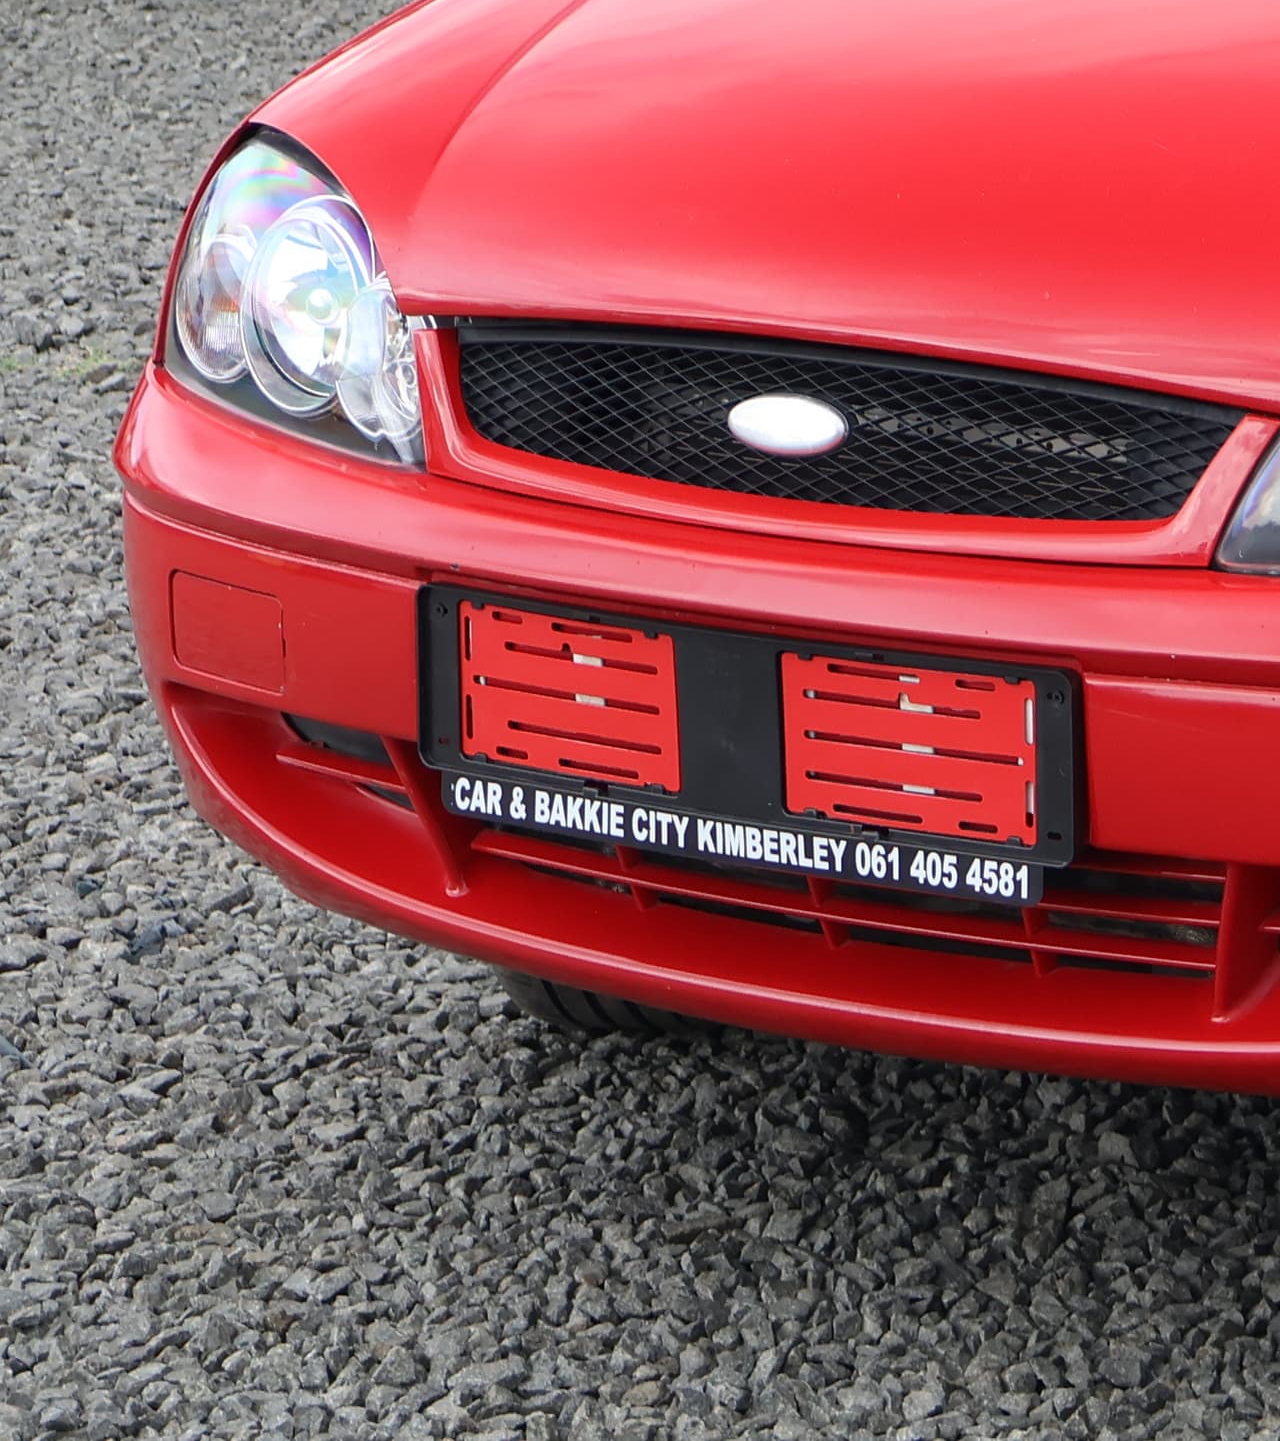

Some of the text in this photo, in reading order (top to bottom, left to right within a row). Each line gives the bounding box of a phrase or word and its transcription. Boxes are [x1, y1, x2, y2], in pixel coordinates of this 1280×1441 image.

[454, 777, 1029, 900] CAR & BAKKIE CITY KIMBERLEY 061 405 4581
